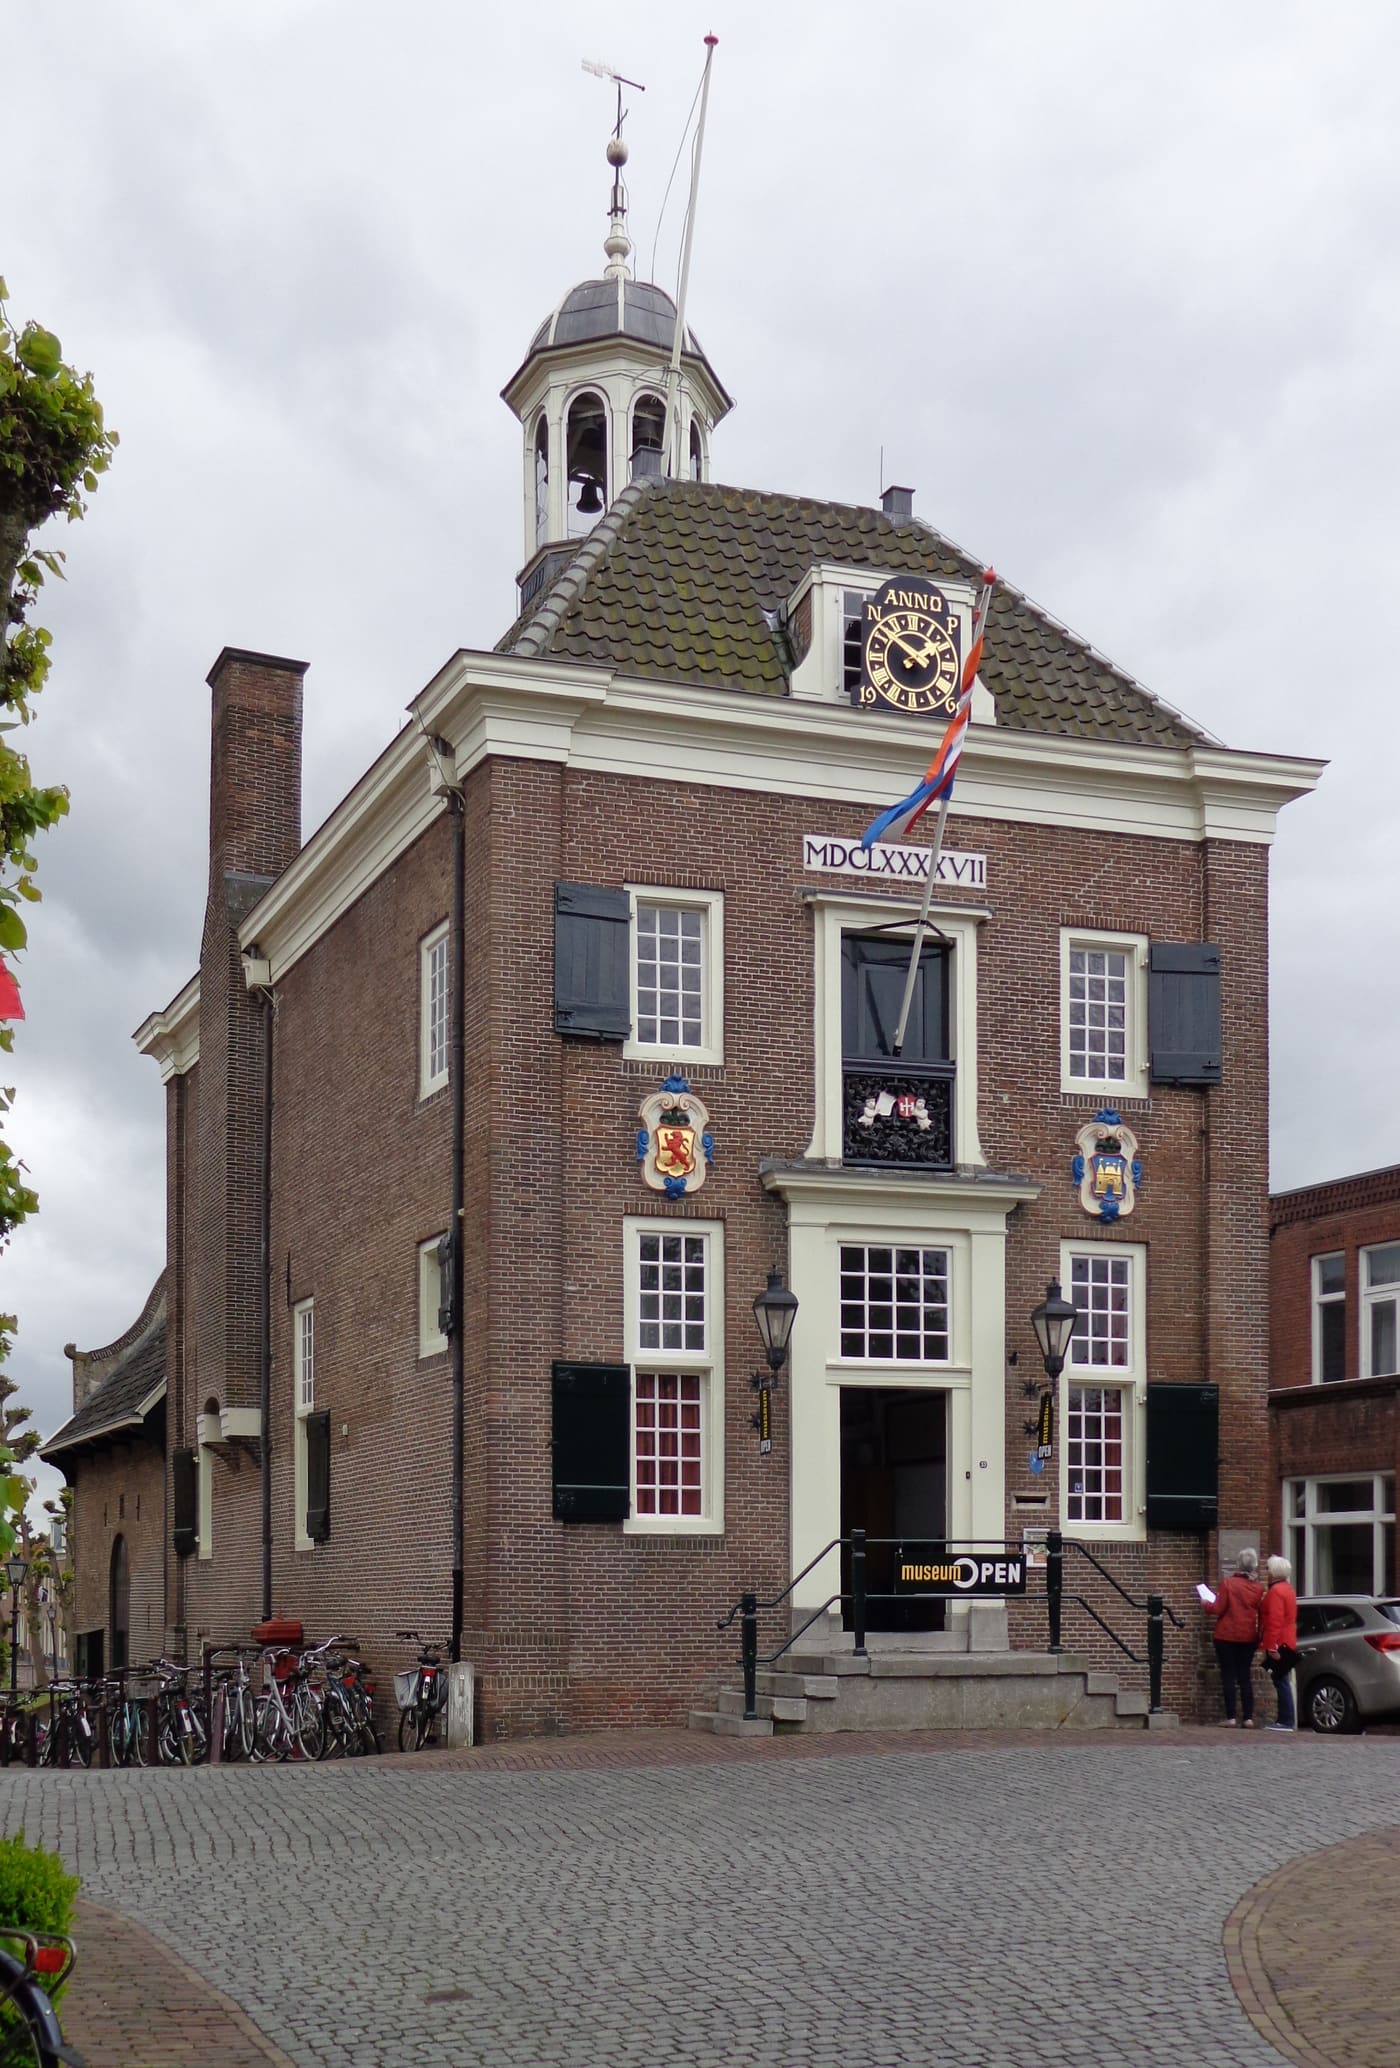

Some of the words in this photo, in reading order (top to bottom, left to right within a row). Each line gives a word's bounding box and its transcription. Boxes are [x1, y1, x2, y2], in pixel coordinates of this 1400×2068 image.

[885, 589, 942, 612] ANNO
[946, 616, 958, 634] P
[860, 685, 876, 703] 19
[901, 1565, 961, 1581] museum
[953, 1558, 1021, 1588] OPEN
